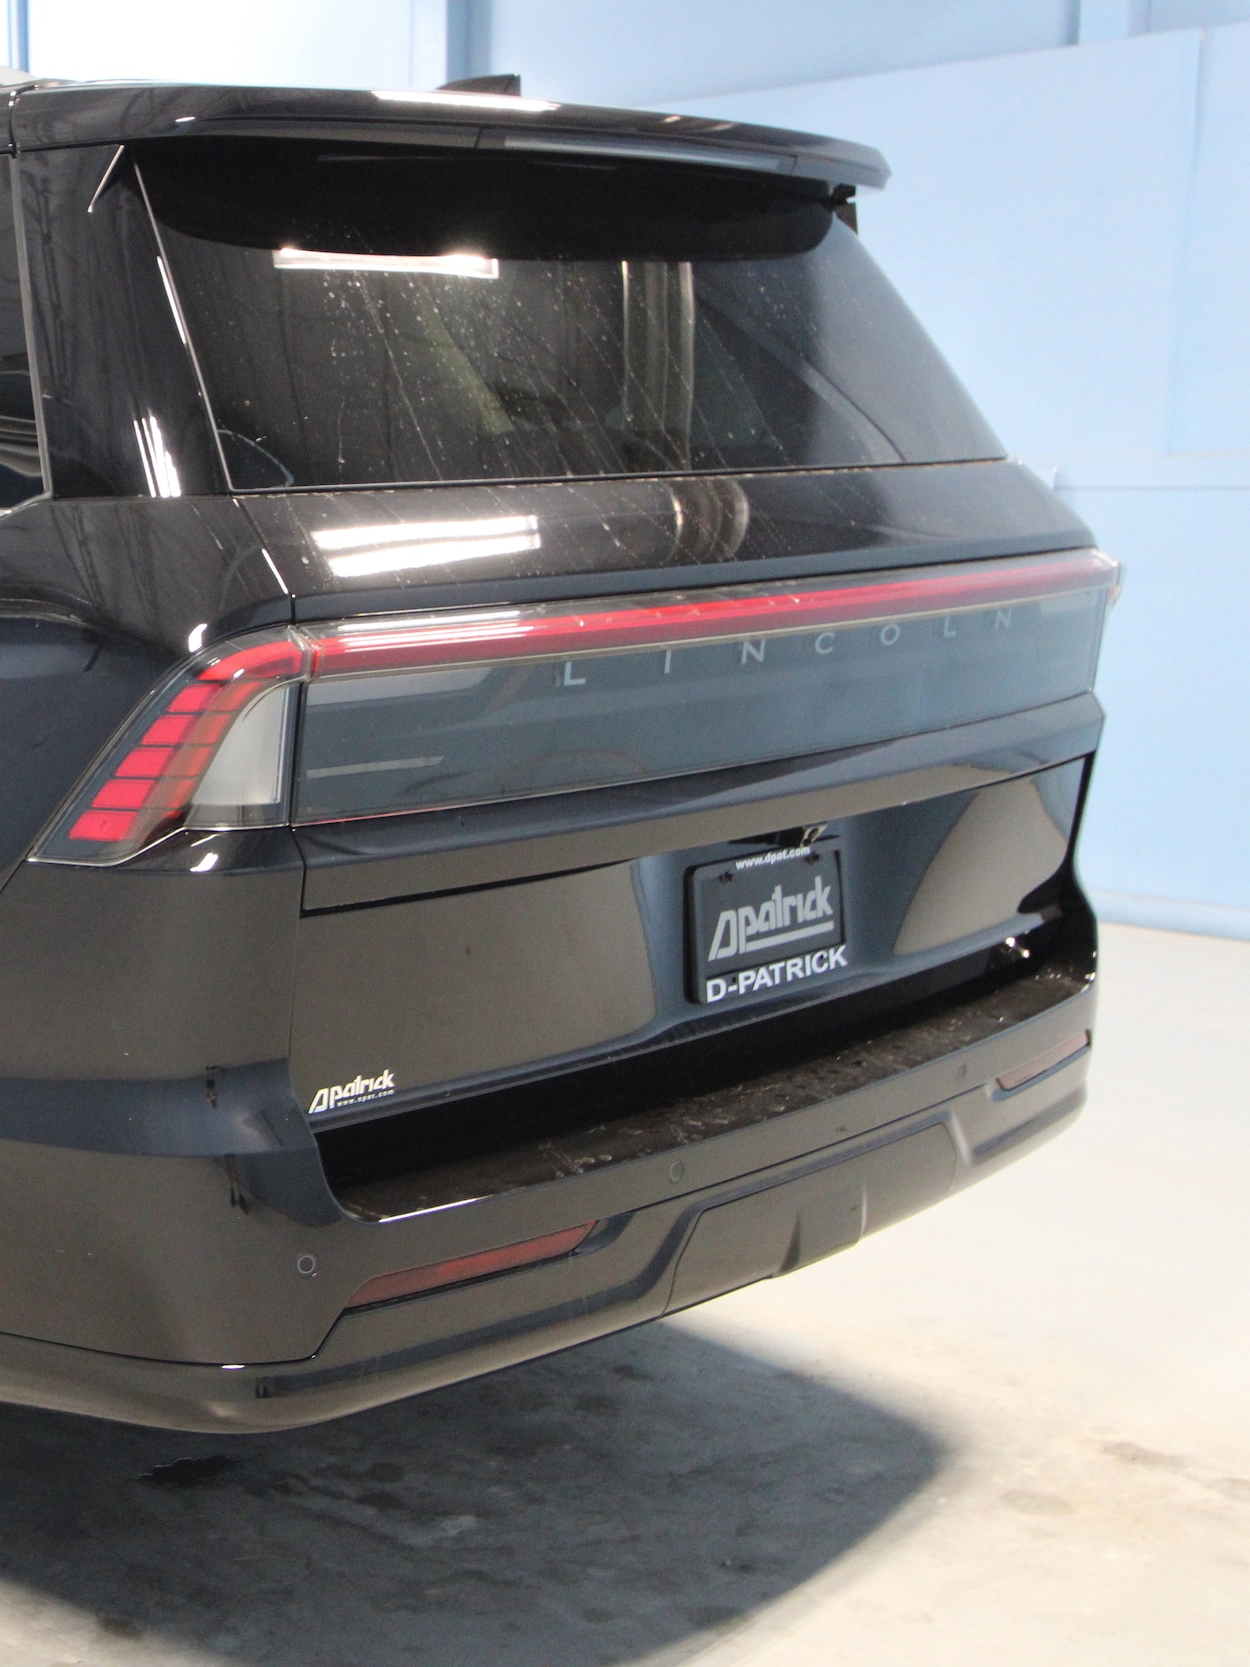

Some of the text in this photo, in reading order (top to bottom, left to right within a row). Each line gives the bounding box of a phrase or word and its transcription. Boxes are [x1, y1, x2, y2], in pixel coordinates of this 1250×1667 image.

[562, 608, 1013, 686] LINCOLN
[735, 846, 810, 869] www.dpat.com
[706, 945, 848, 1003] D-PATRICK
